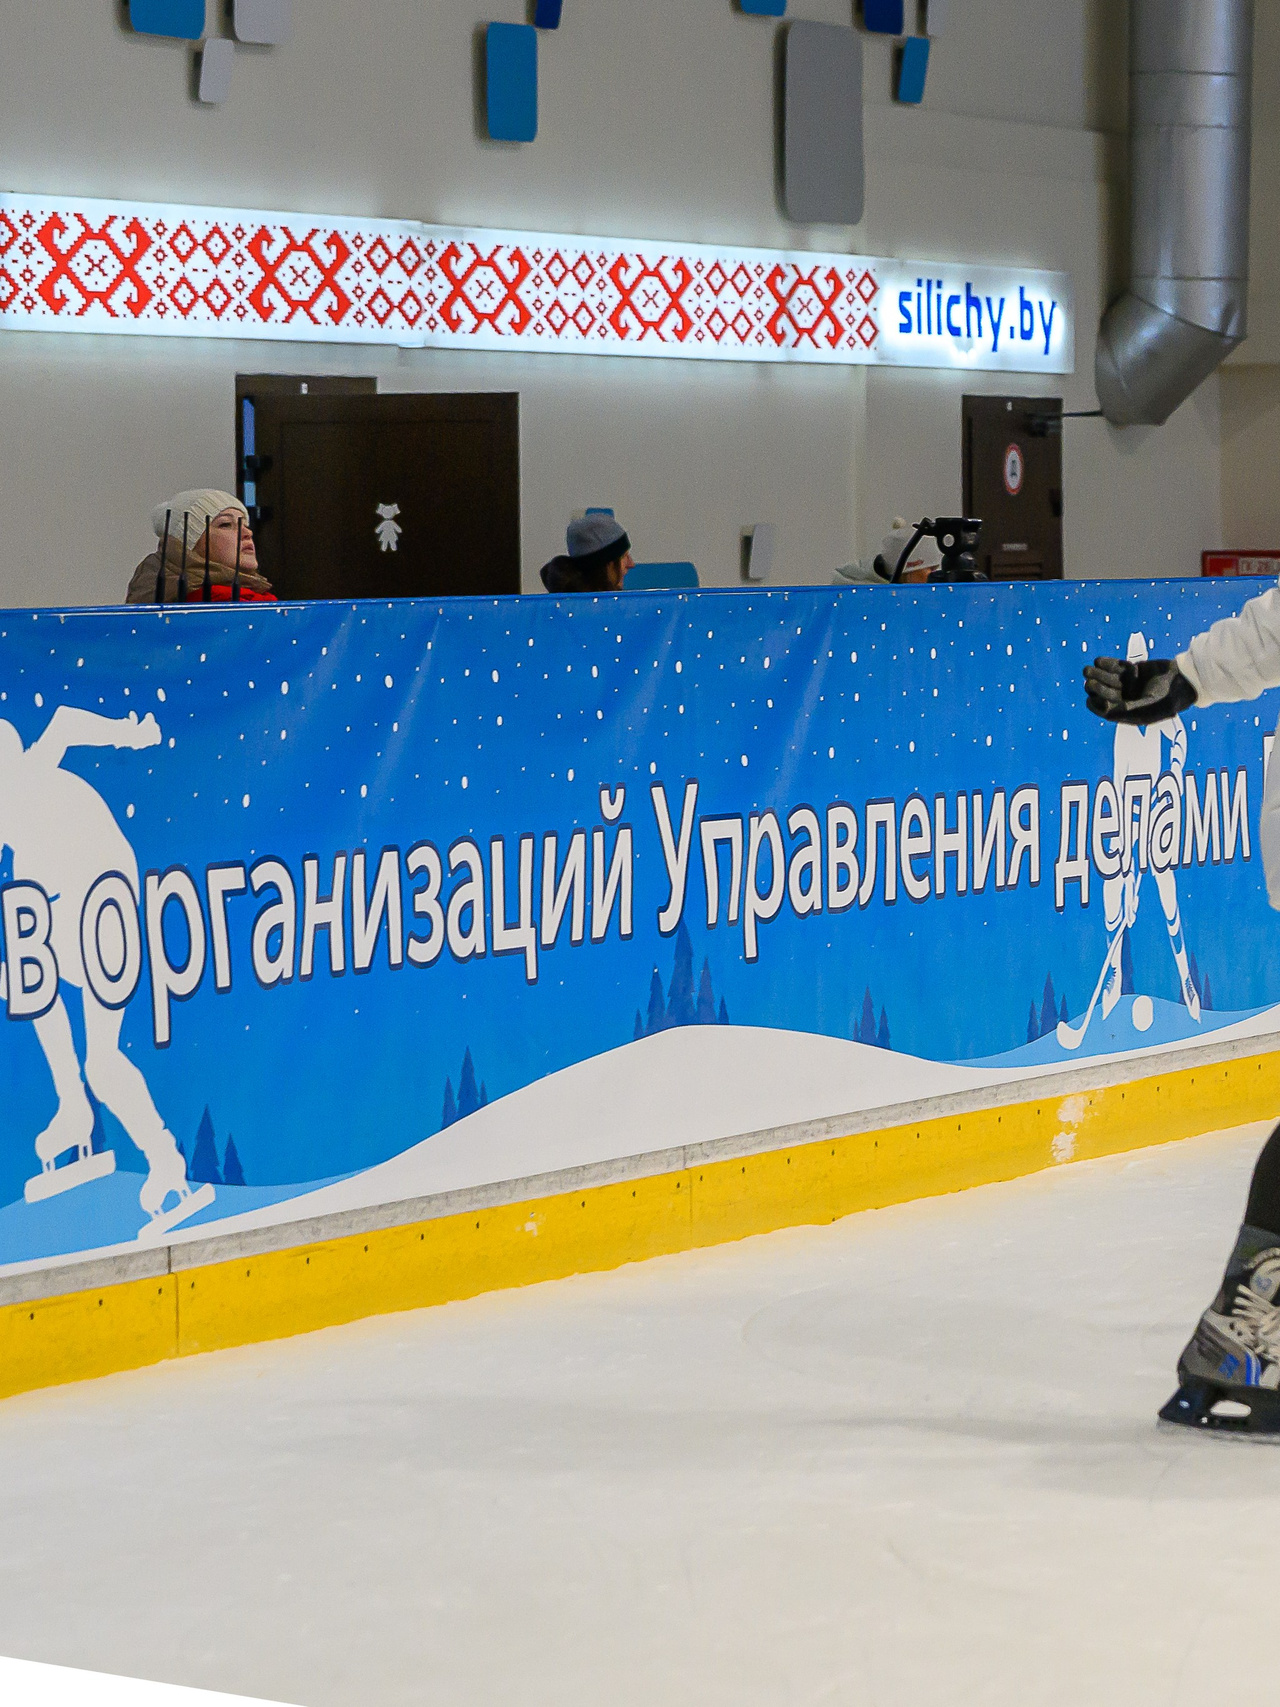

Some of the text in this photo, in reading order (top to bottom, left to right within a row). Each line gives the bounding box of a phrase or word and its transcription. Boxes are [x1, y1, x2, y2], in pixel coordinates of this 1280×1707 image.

[898, 278, 1057, 355] silichy.by
[80, 782, 636, 1049] организаций
[650, 778, 1041, 963] Управления
[1055, 765, 1252, 912] делами
